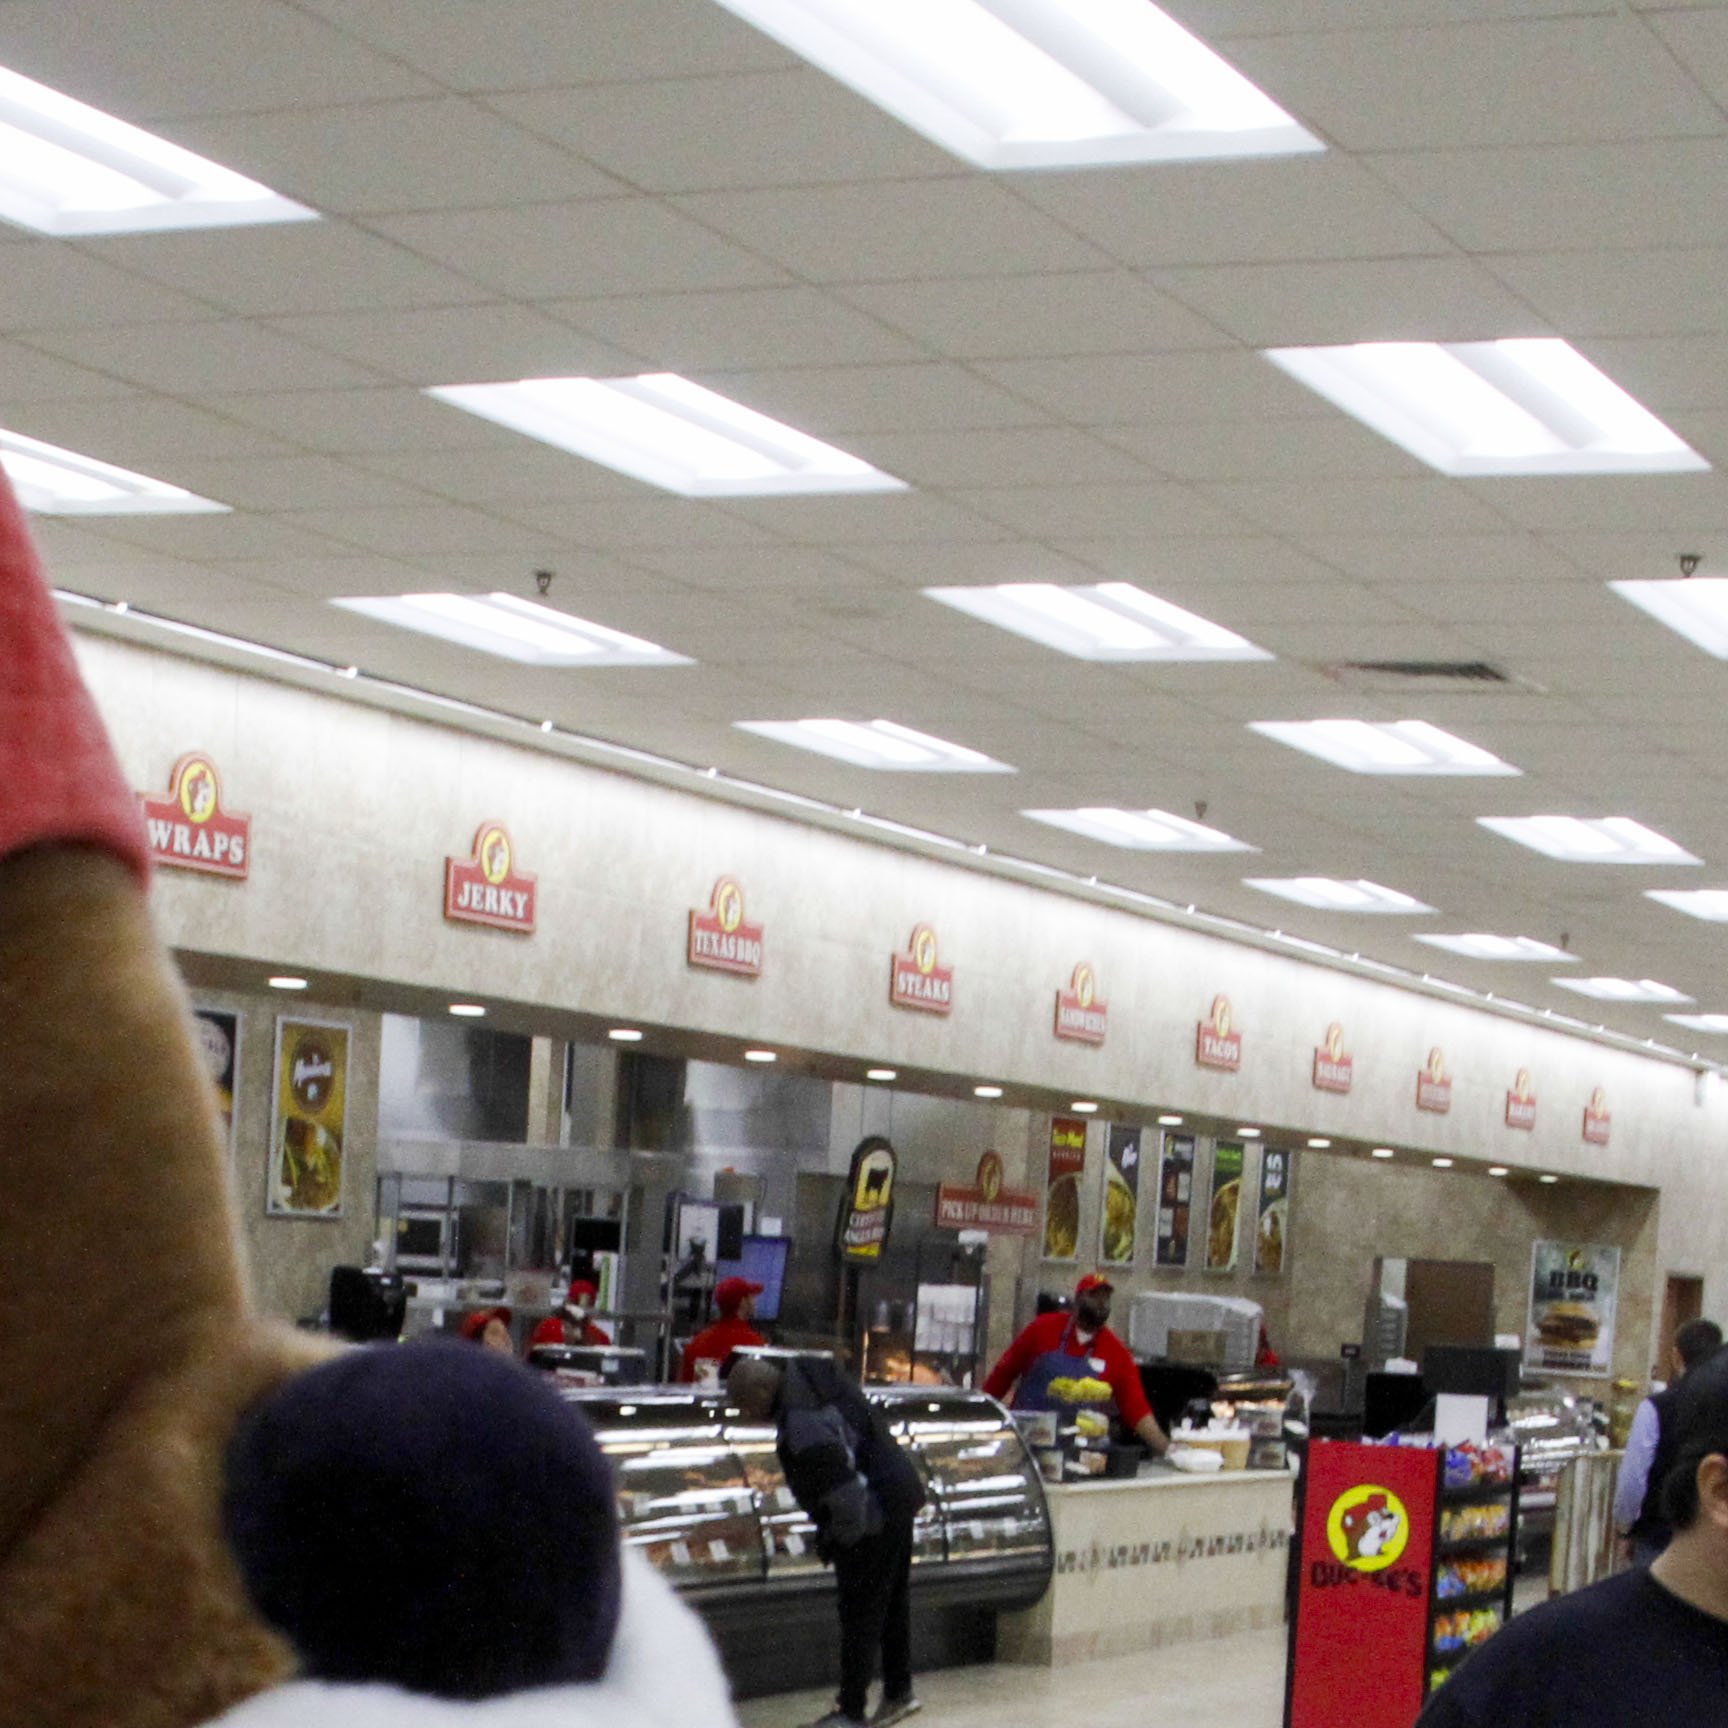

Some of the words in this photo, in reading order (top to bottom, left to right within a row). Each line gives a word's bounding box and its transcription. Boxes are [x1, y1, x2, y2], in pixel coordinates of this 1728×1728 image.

[147, 818, 245, 865] WRAPS
[458, 881, 529, 919] JERKY
[695, 931, 735, 959] TEXAS
[735, 935, 761, 966] BBQ
[898, 970, 950, 1002] STEAKS
[1203, 1037, 1239, 1061] TACOS
[941, 1201, 964, 1220] PICK
